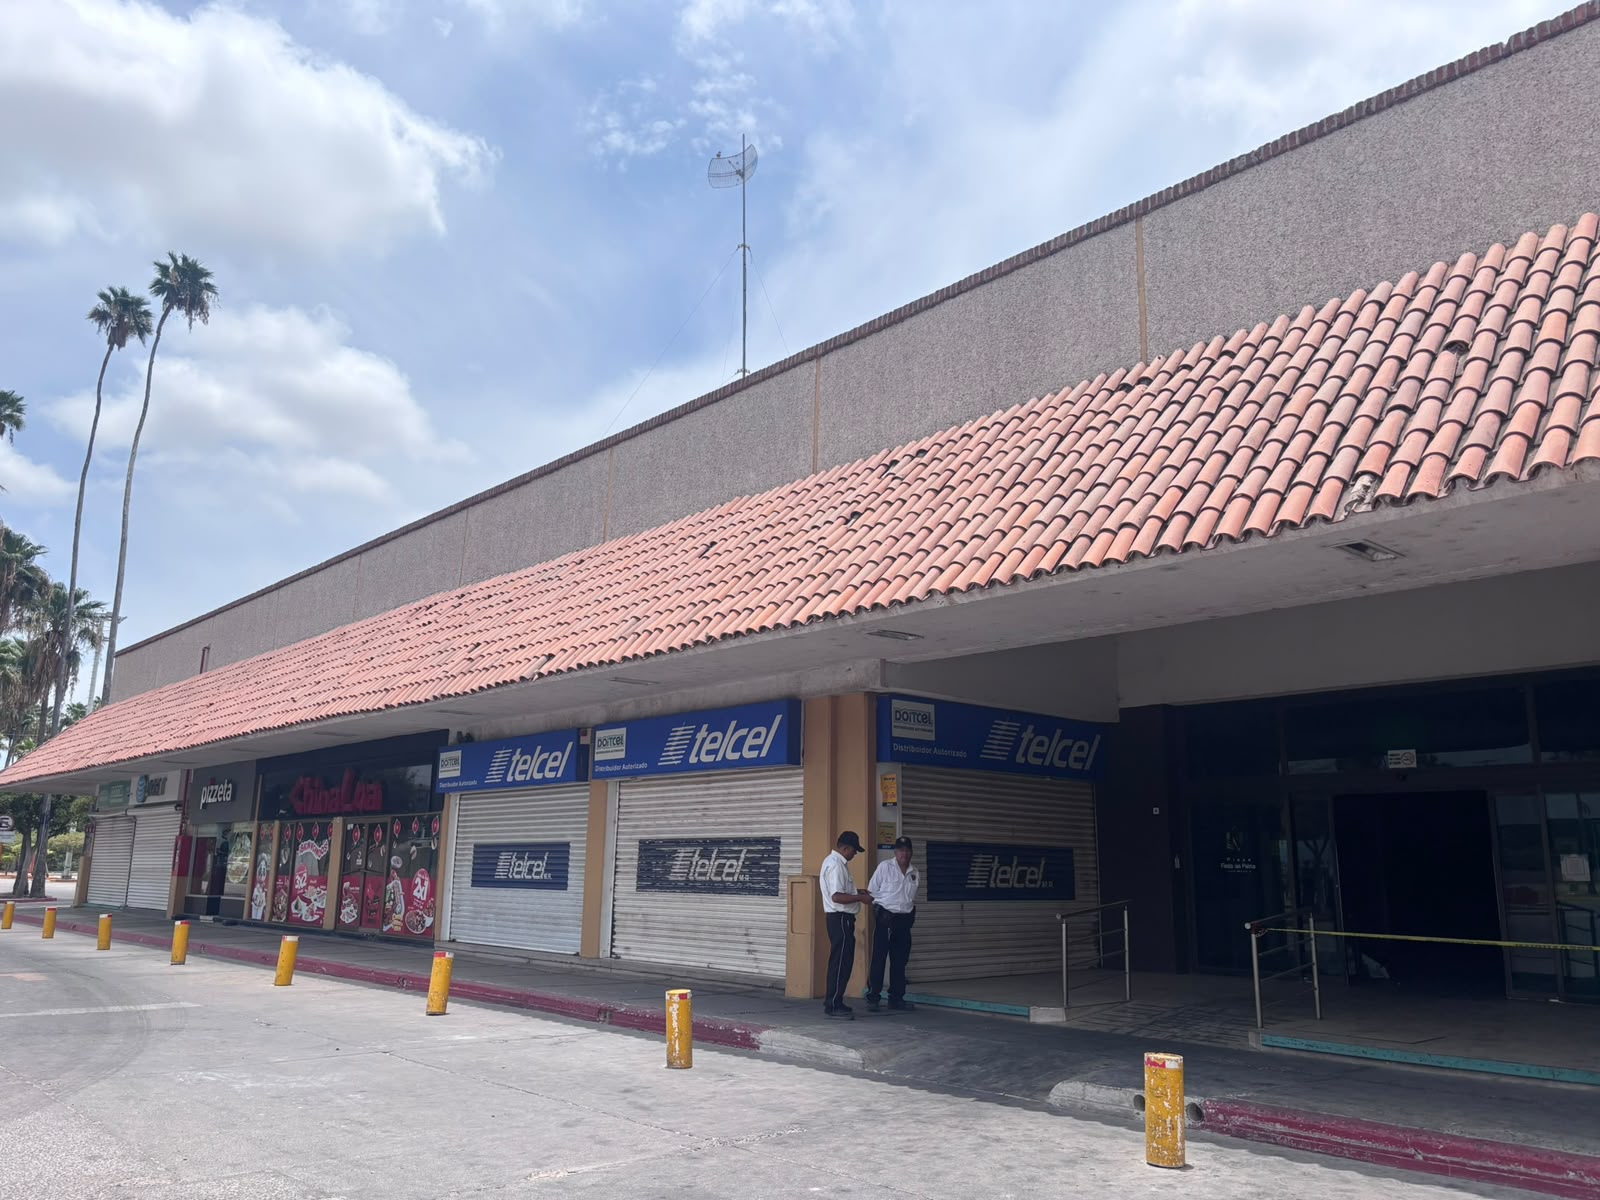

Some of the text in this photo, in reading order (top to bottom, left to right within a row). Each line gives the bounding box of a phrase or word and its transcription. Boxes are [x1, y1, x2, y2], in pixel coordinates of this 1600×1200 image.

[688, 714, 783, 764] telcel
[933, 747, 967, 758] Autorizado
[1015, 724, 1101, 771] telcel
[506, 741, 574, 783] telcel
[622, 761, 648, 771] Autorizado
[200, 779, 233, 810] pizzeta
[508, 852, 549, 879] telcel
[688, 848, 747, 881] telcel
[989, 855, 1046, 888] telcel
